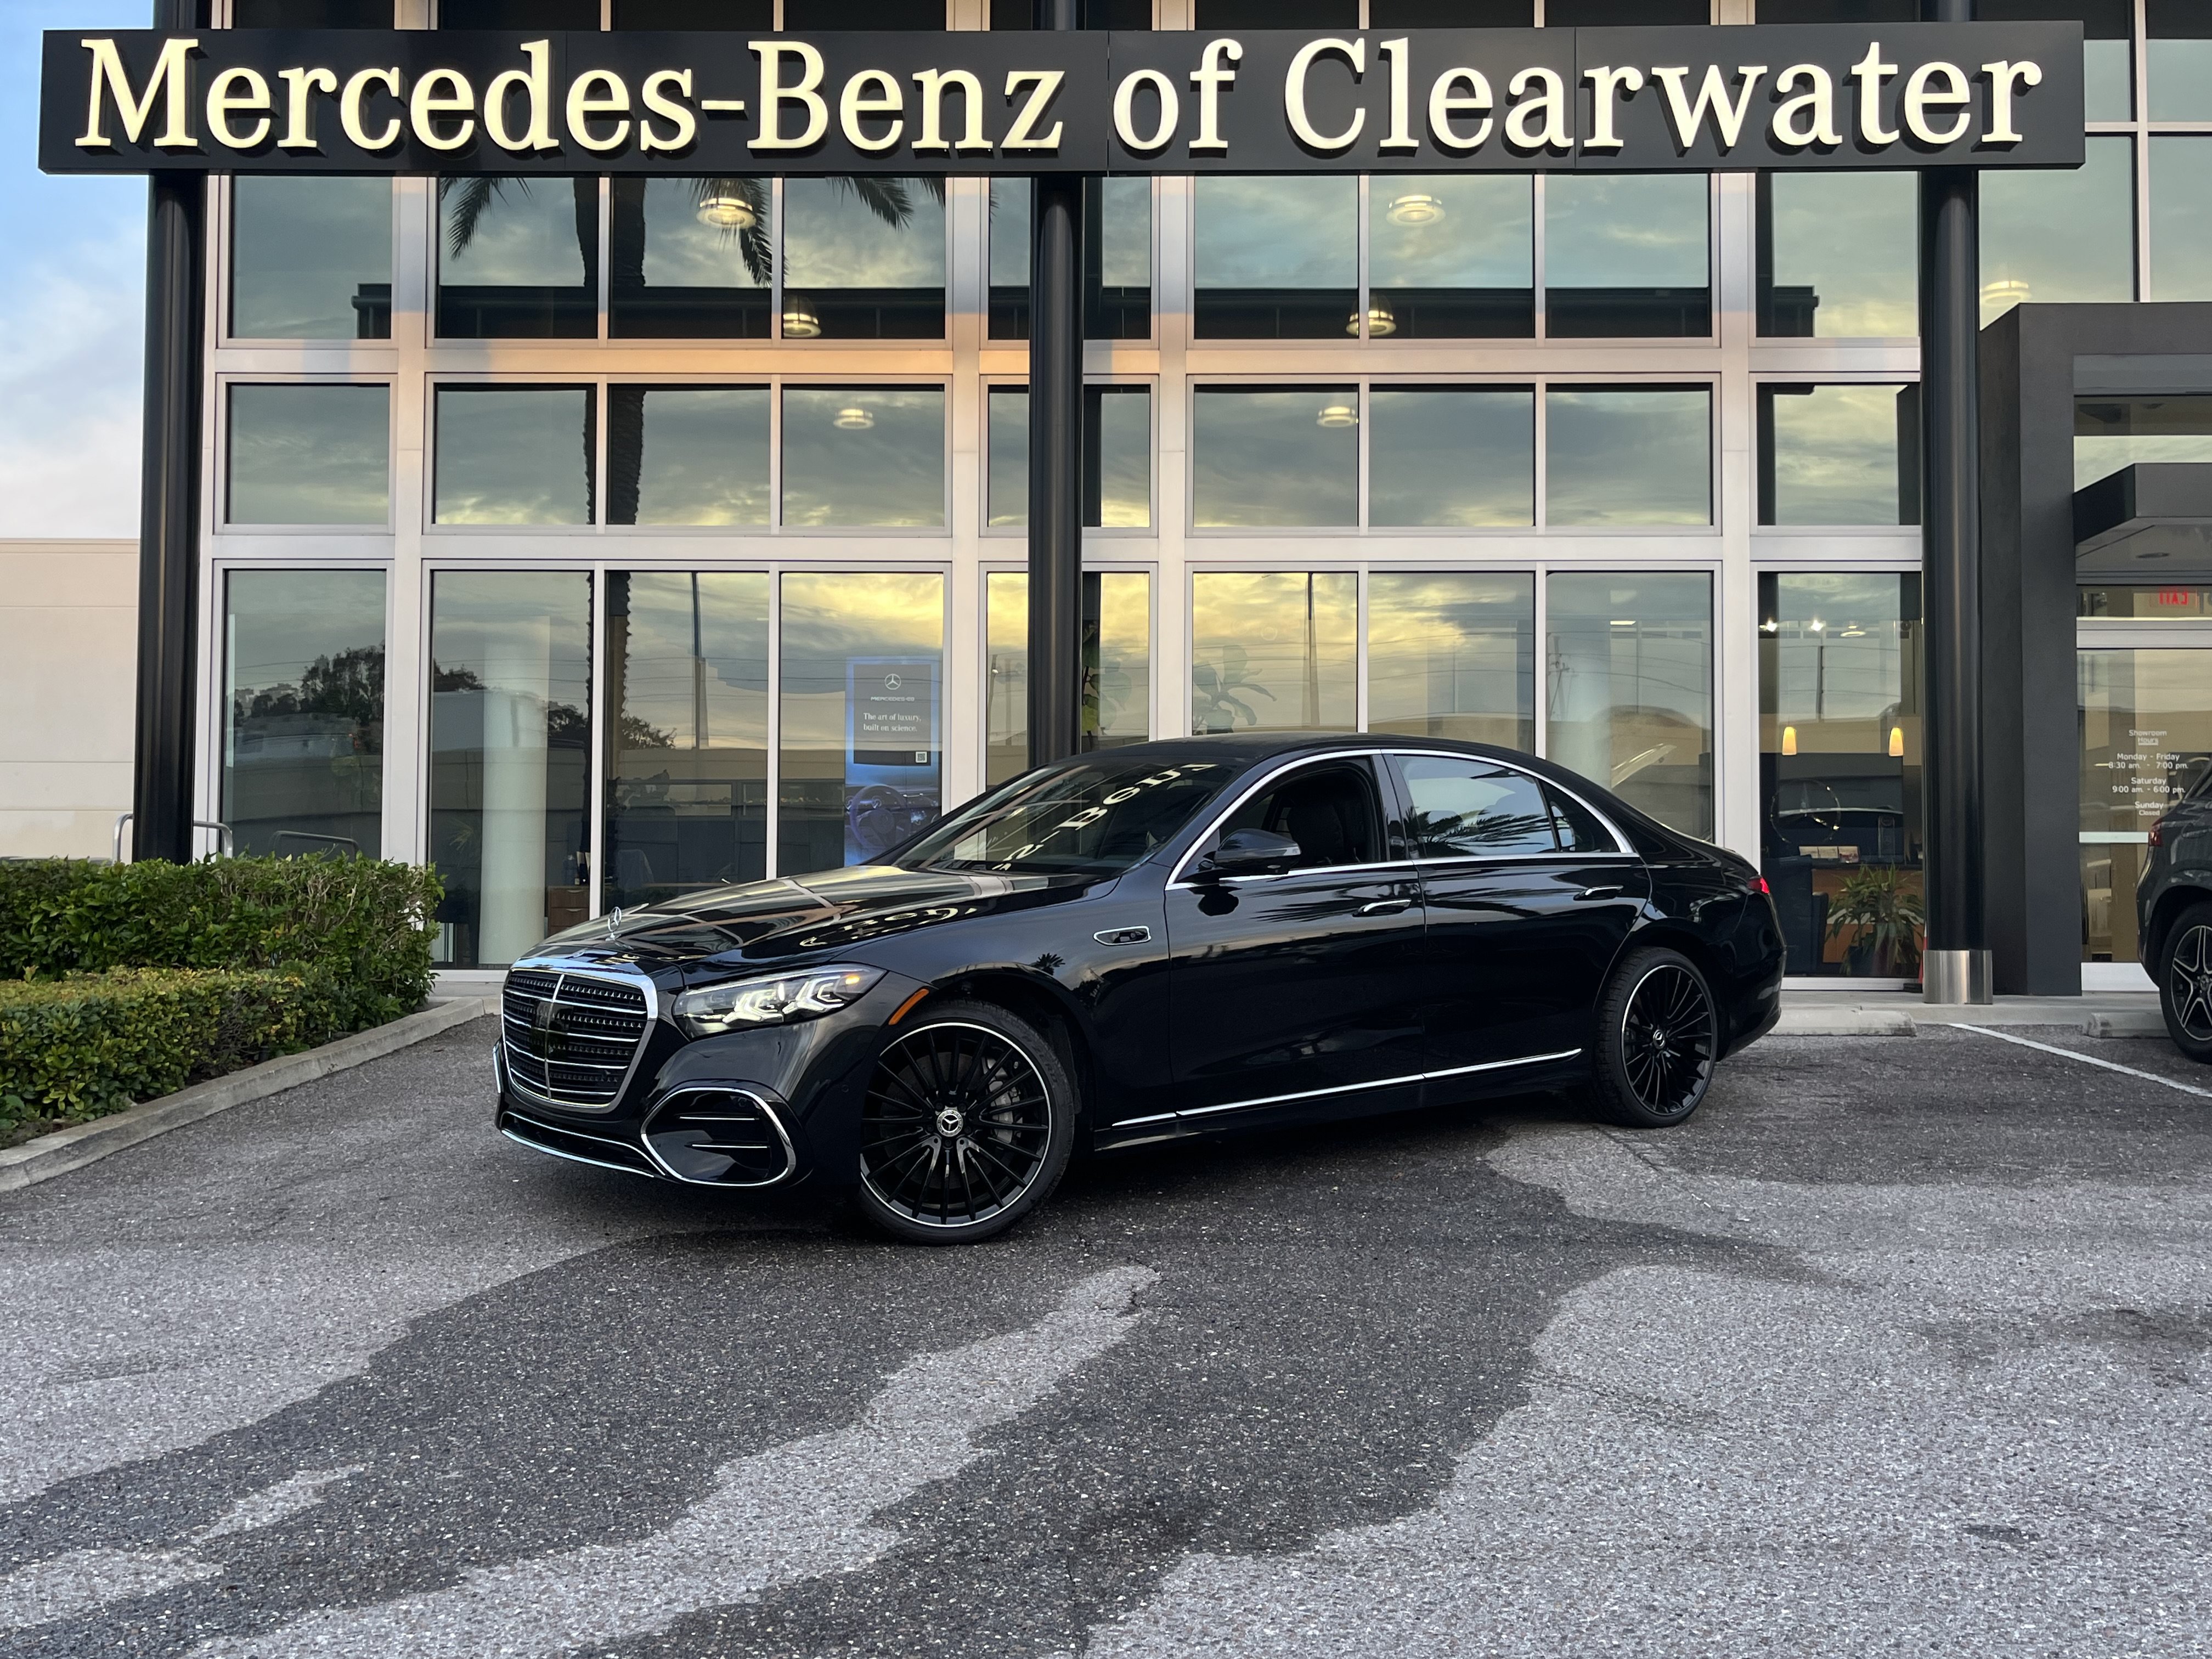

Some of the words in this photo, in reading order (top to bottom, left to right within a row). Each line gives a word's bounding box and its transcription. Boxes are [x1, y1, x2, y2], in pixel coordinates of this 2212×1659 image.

[75, 38, 1065, 151] Mercedes-Benz
[1114, 38, 1243, 149] of
[1285, 37, 2042, 149] Clearwater
[898, 713, 922, 722] luxury,
[2138, 737, 2158, 746] Hours
[2117, 753, 2147, 761] Monday
[2131, 777, 2167, 785] Saturday
[2135, 801, 2164, 809] Sunday
